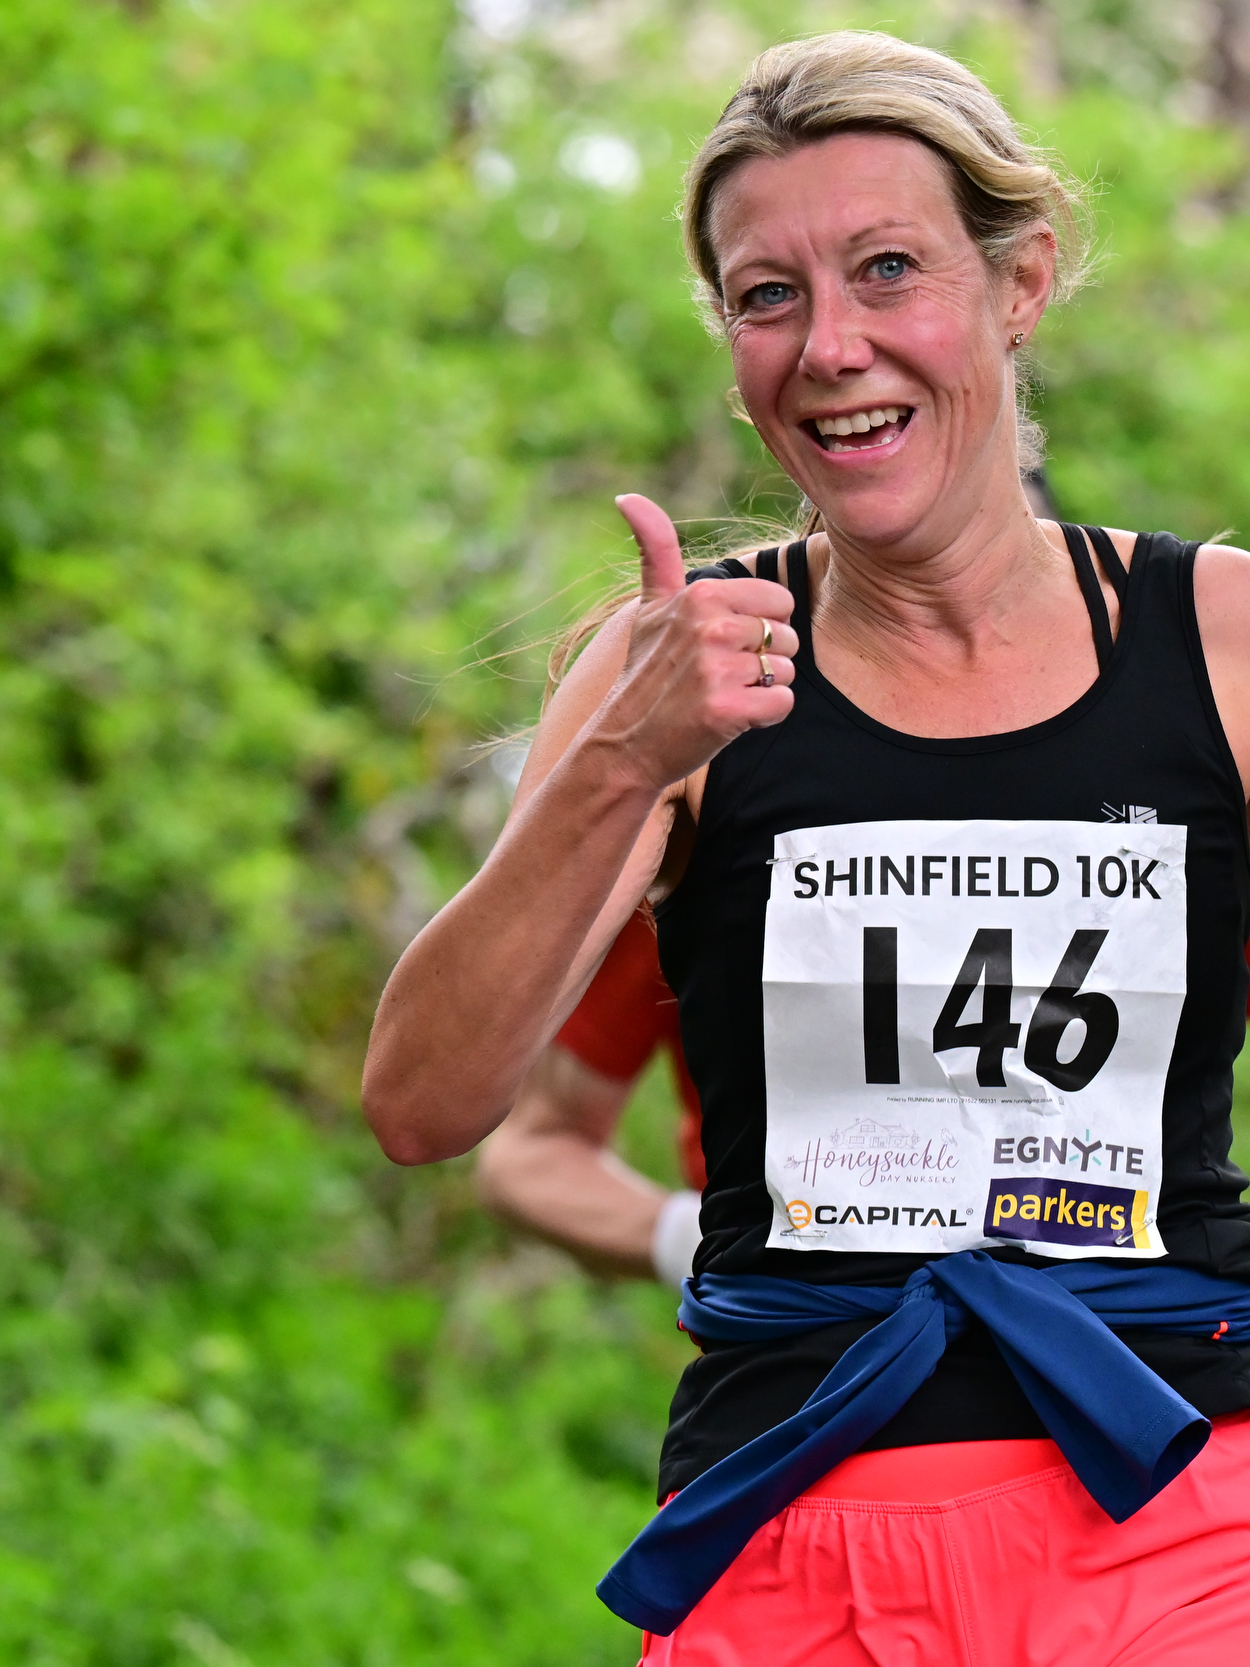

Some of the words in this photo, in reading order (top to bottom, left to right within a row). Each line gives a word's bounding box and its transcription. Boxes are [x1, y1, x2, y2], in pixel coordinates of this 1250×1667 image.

[794, 855, 1059, 899] SHINFIELD
[1077, 855, 1162, 899] 10K
[863, 926, 1119, 1092] 146
[801, 1137, 960, 1188] Honeysuckle
[993, 1136, 1144, 1175] EGNYTE
[880, 1174, 901, 1183] DAY
[905, 1174, 957, 1184] NURSERY
[992, 1188, 1126, 1231] parkers
